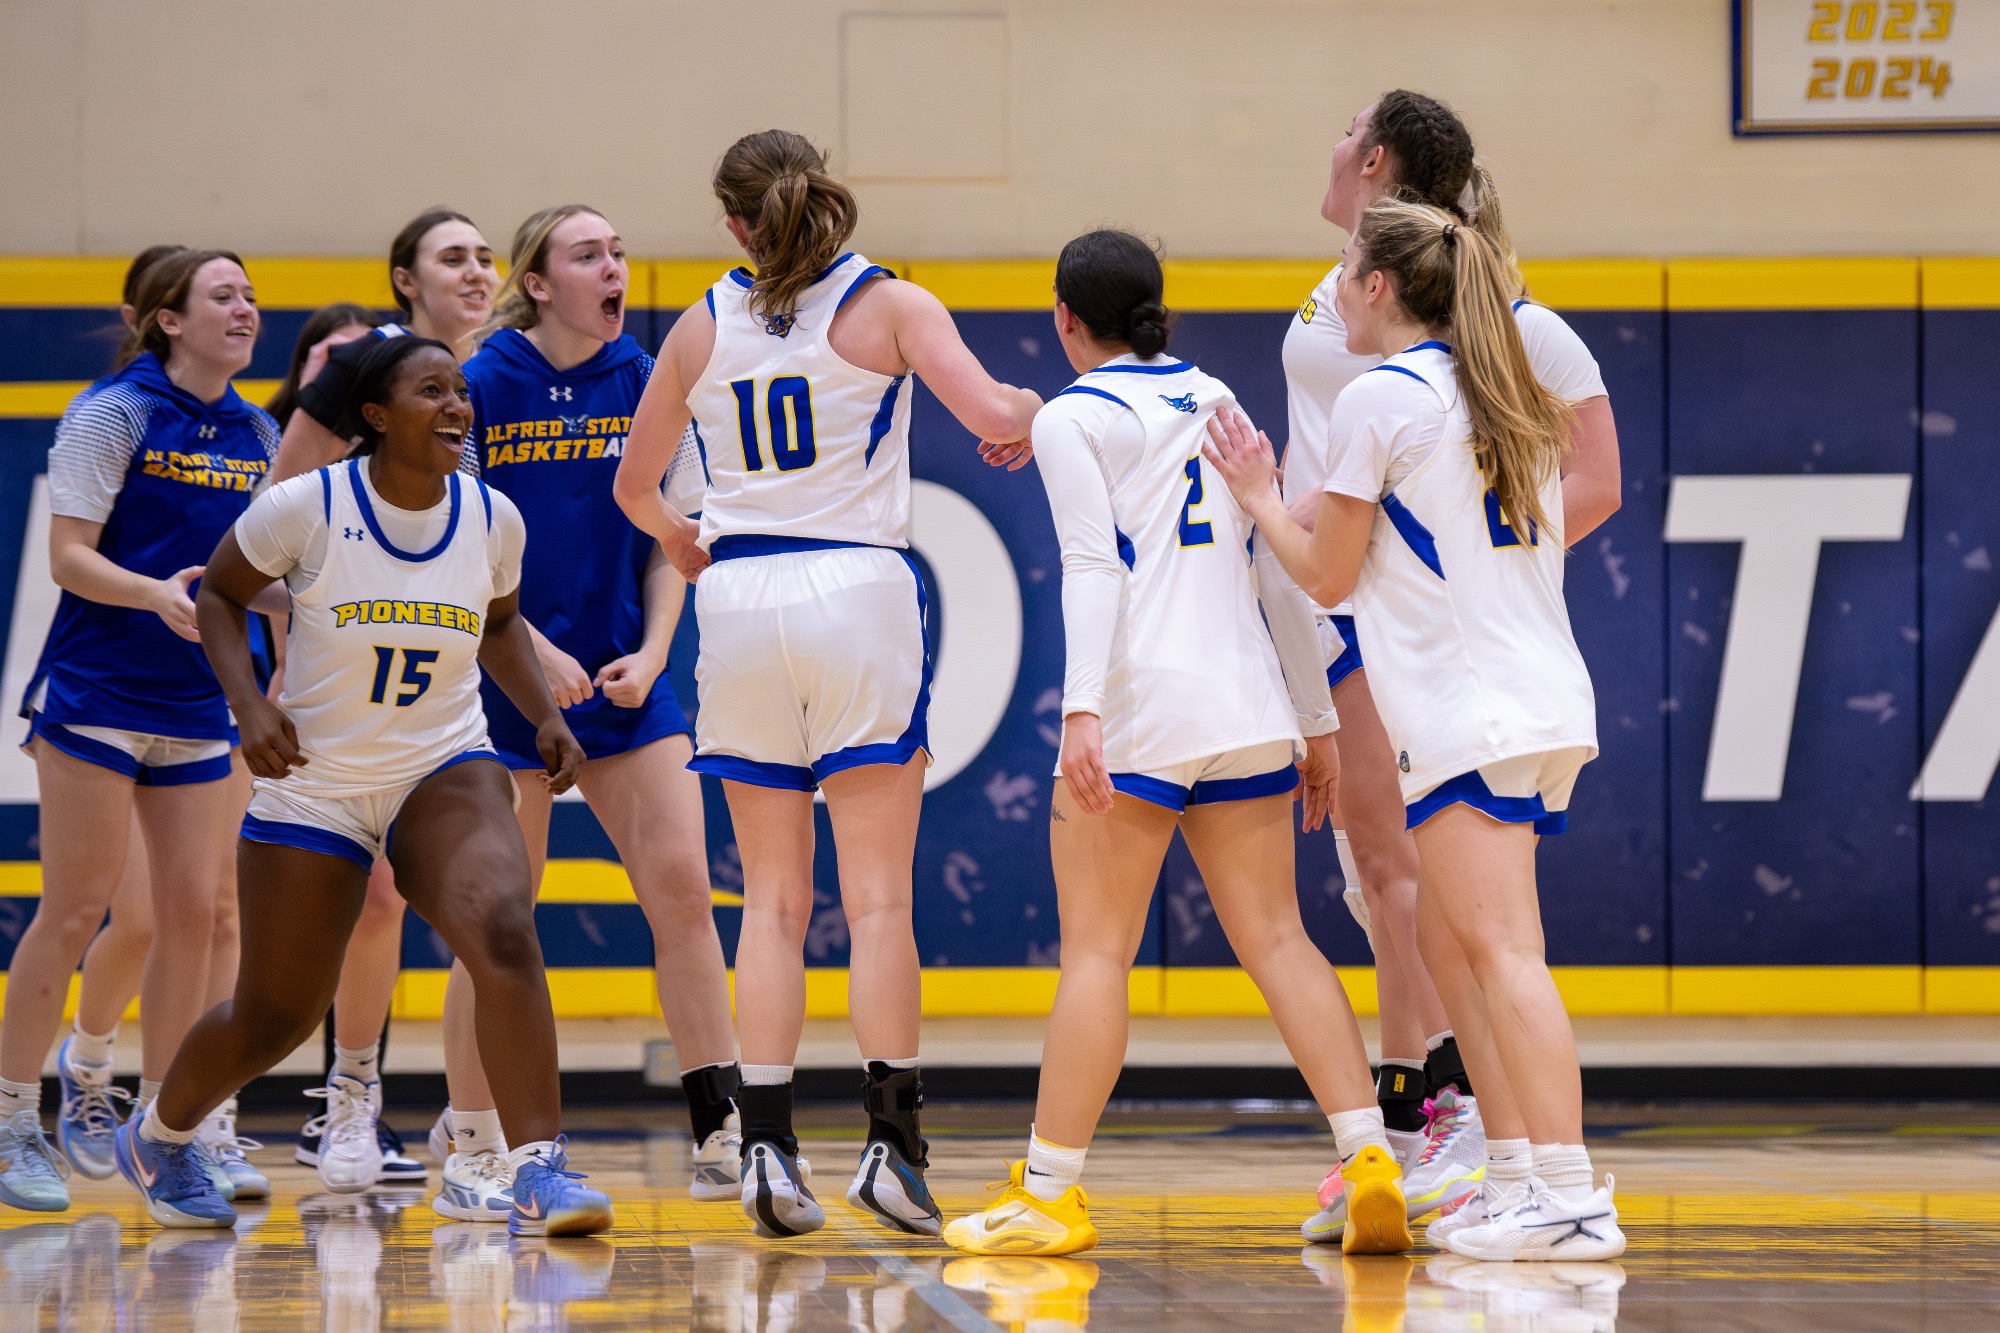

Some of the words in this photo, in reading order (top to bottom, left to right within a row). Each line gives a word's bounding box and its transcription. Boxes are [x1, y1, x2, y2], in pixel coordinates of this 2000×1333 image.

[1808, 0, 1953, 41] 2023
[1806, 57, 1952, 99] 2024
[485, 420, 564, 444] ALFRED
[585, 416, 634, 435] STAT
[727, 373, 819, 474] 10
[1176, 452, 1216, 550] 2
[329, 599, 480, 637] PIONEERS
[368, 643, 441, 708] 15
